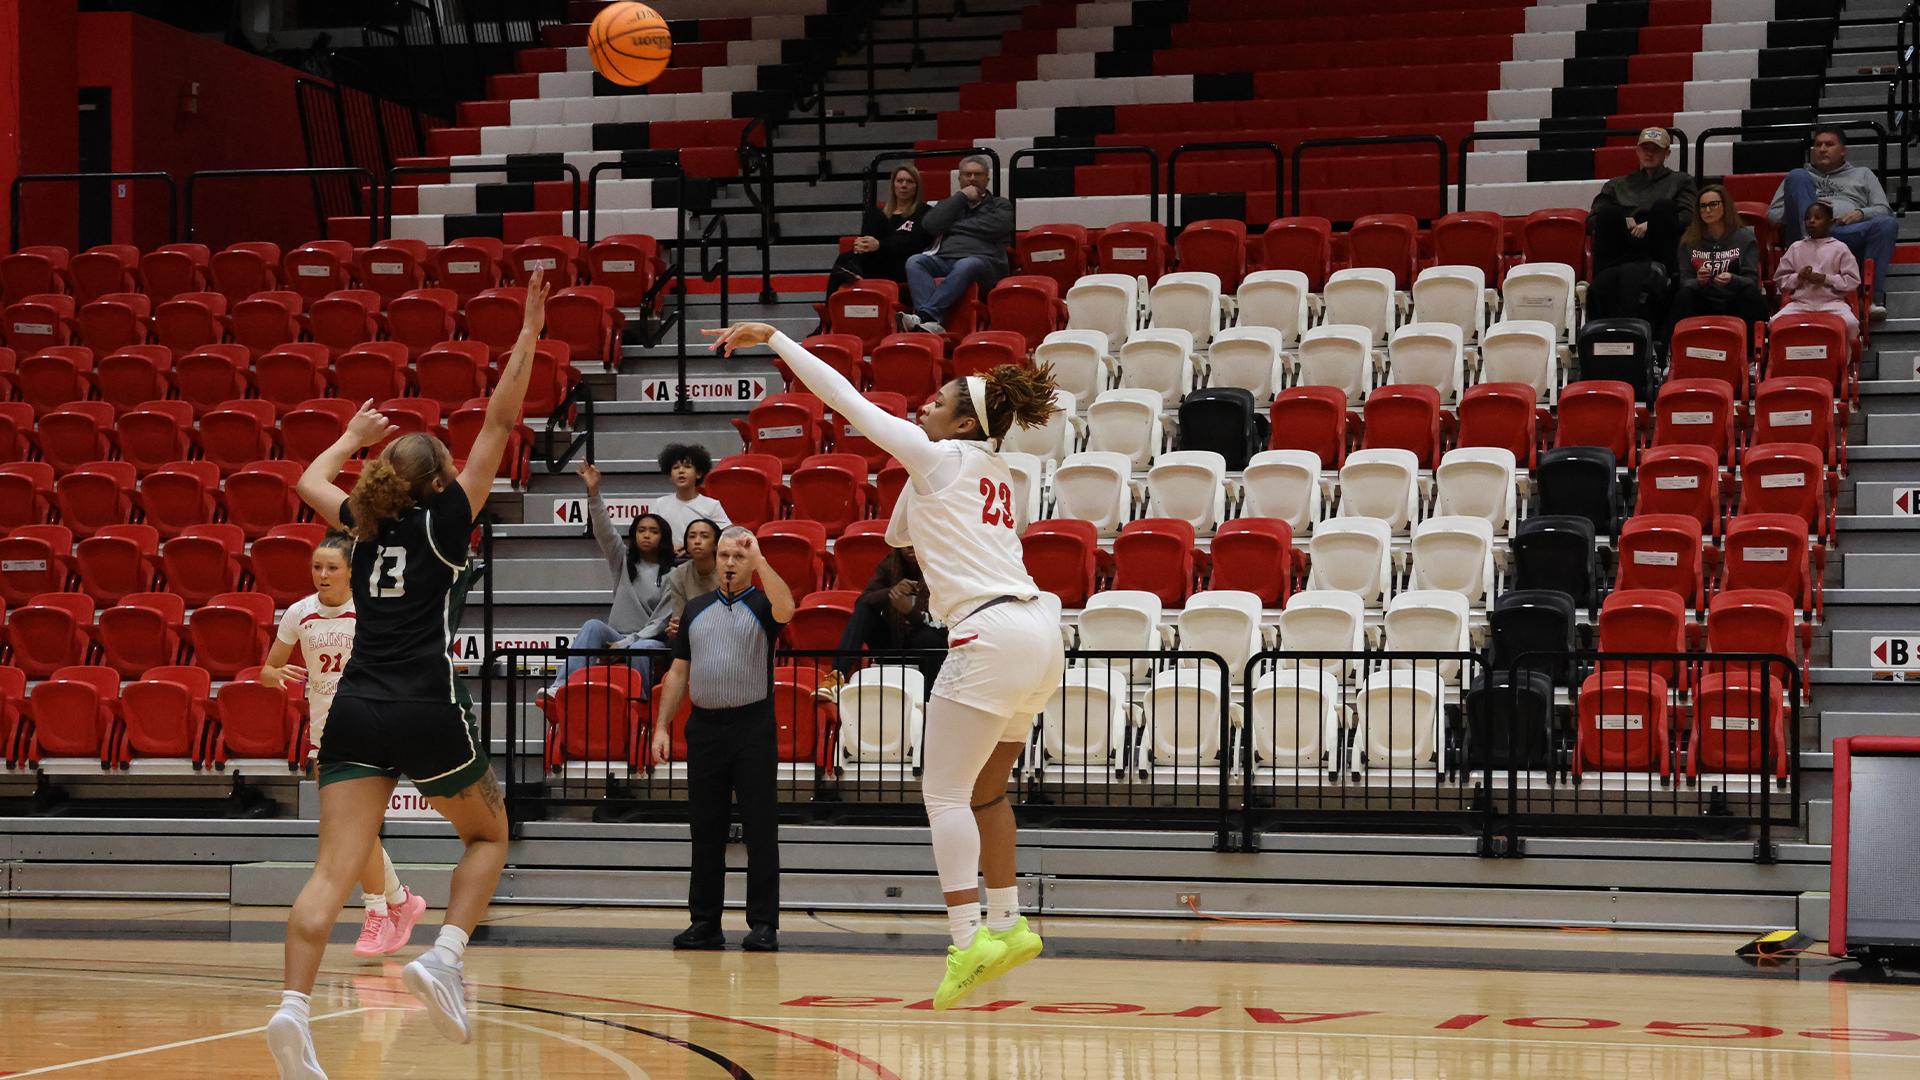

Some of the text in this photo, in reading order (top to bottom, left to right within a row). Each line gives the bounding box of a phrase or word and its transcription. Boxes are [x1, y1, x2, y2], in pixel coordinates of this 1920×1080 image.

[1692, 249, 1711, 259] SAINT
[656, 381, 669, 401] A
[738, 379, 751, 400] B
[569, 500, 649, 523] A CTION
[979, 477, 1014, 529] 23
[369, 544, 407, 598] 13
[309, 631, 354, 651] SAINT
[464, 635, 479, 660] A
[494, 640, 549, 651] ECTION
[319, 652, 342, 674] 21
[1891, 639, 1909, 666] B
[390, 794, 432, 810] CTIO
